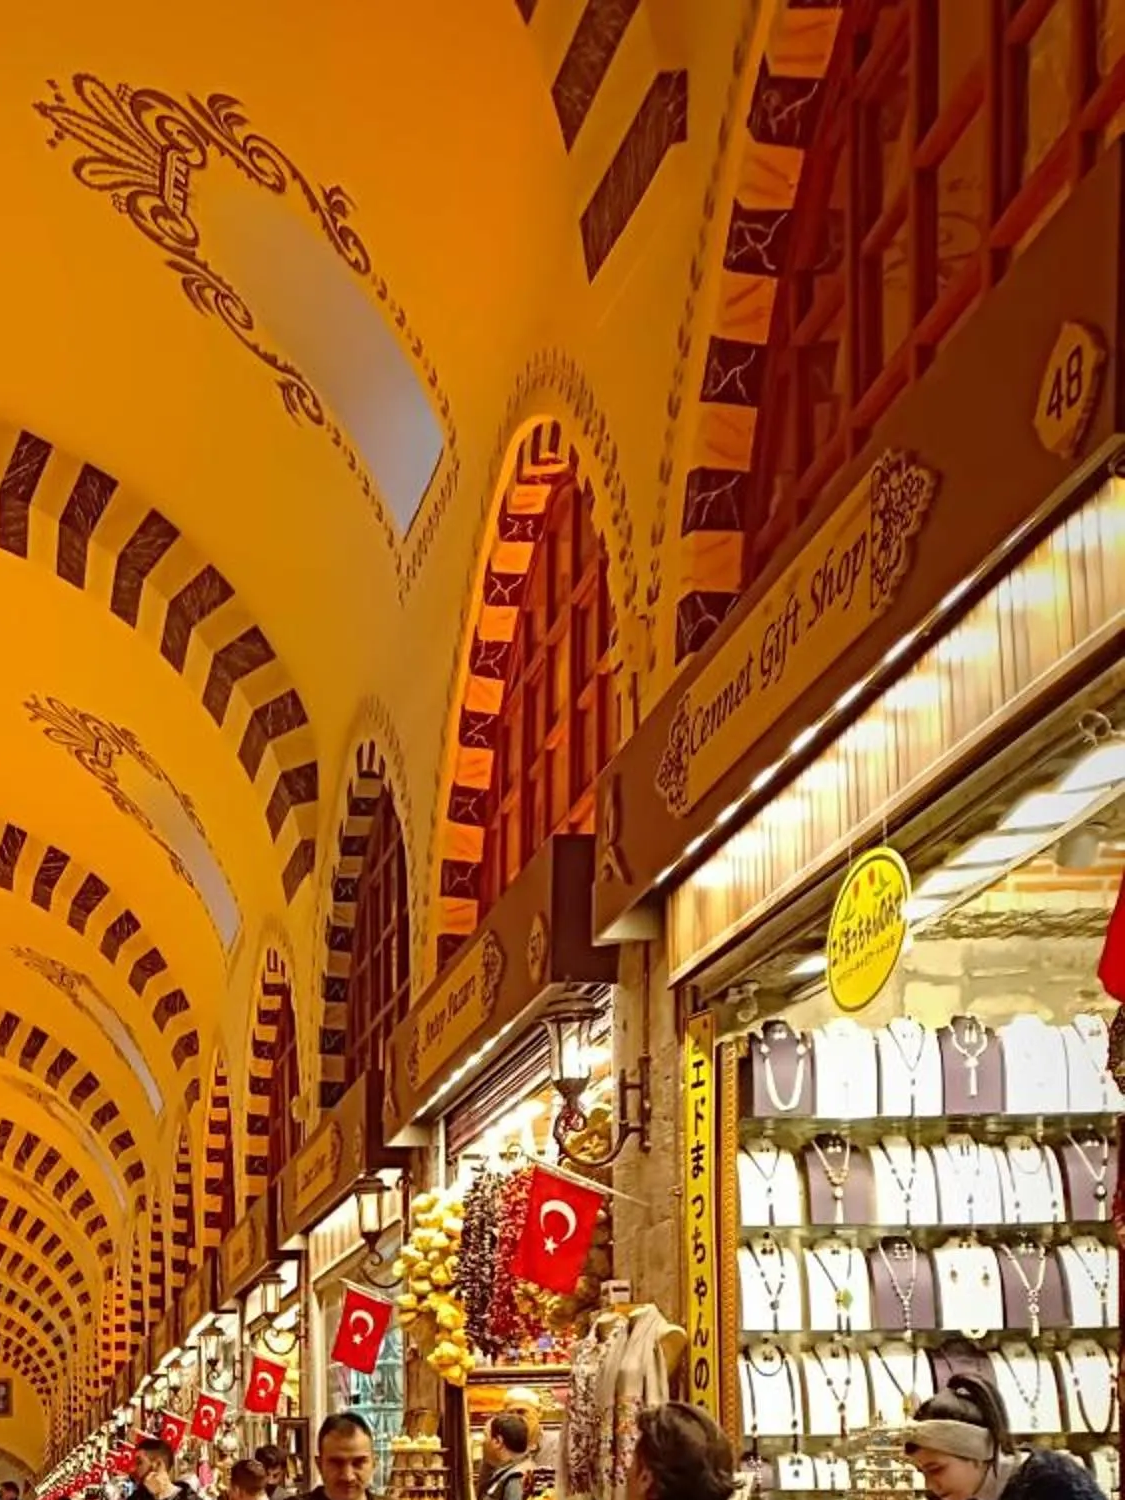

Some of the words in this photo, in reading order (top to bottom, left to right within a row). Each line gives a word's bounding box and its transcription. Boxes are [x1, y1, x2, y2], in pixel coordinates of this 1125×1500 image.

[1046, 344, 1083, 421] 48
[689, 651, 755, 757] Cennet
[760, 592, 801, 691] Gift
[807, 532, 867, 630] Shop
